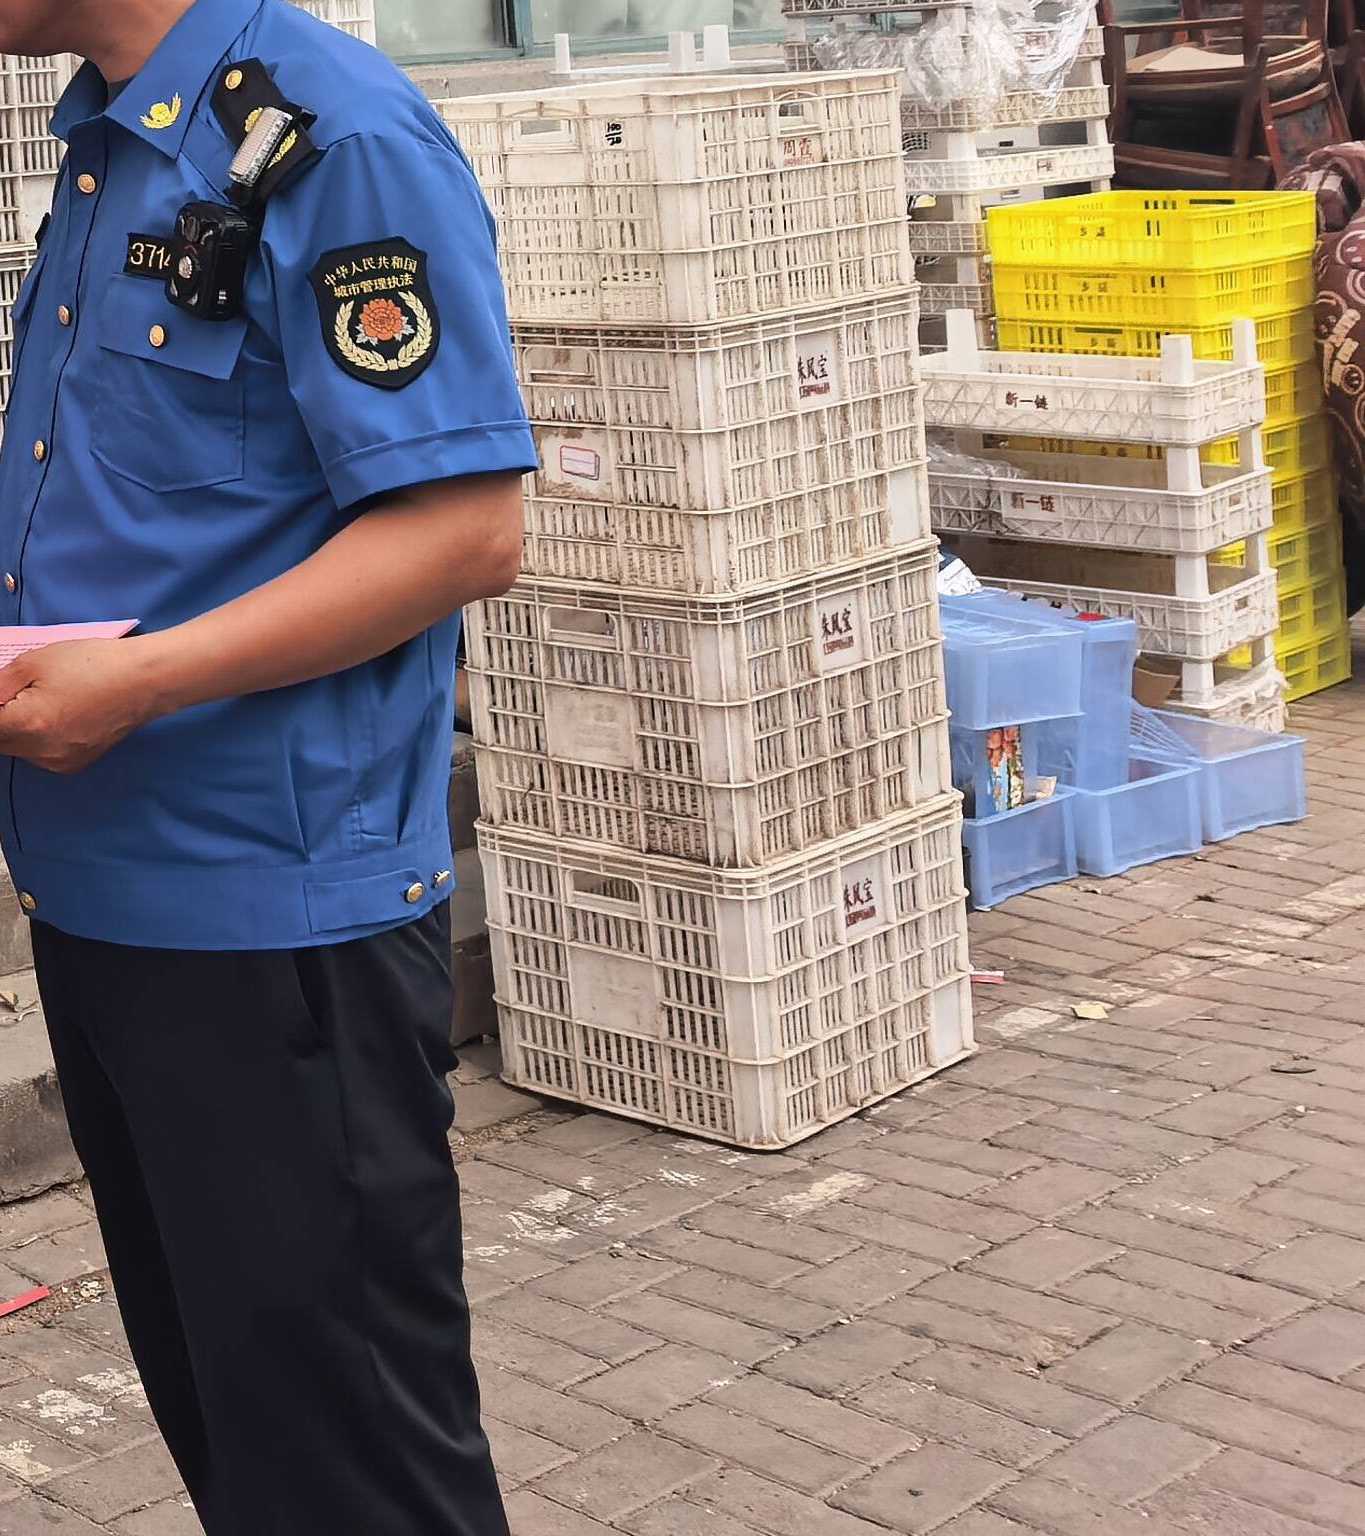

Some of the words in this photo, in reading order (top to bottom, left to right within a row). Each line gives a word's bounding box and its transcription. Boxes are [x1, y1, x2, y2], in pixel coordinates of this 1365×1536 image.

[324, 256, 418, 286] 中华人民共和国
[333, 272, 414, 298] 城市管理执法
